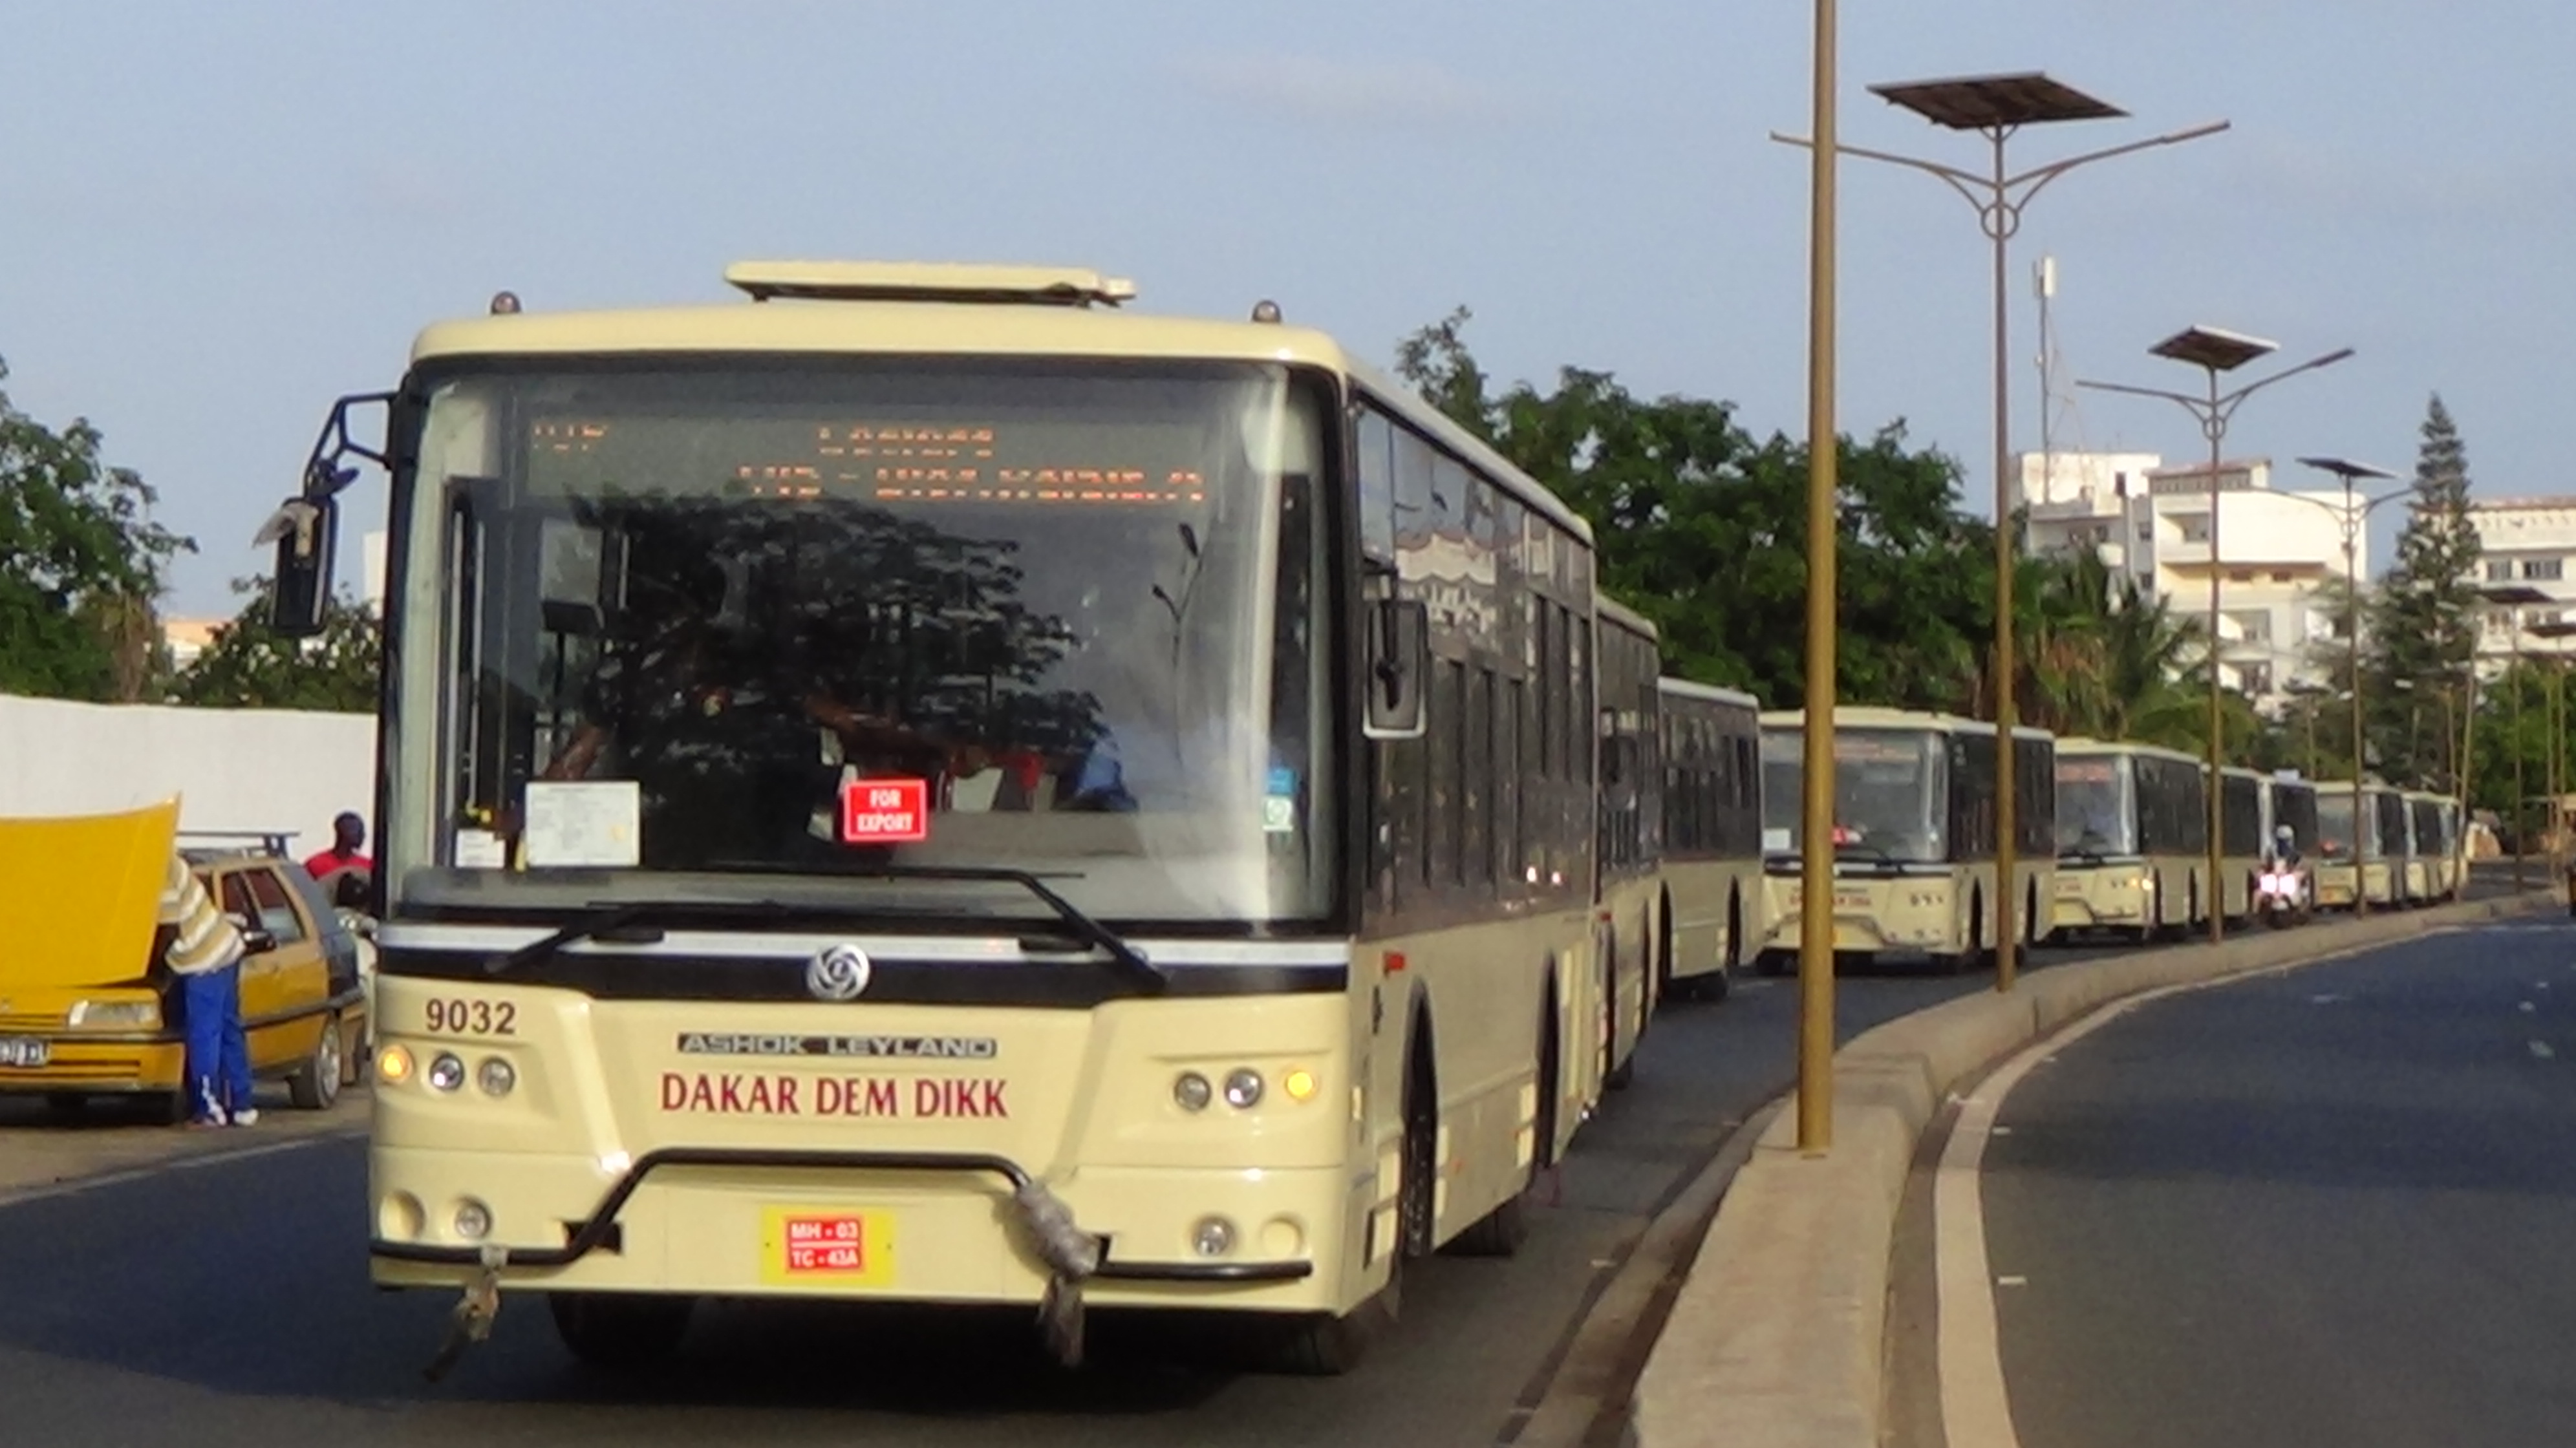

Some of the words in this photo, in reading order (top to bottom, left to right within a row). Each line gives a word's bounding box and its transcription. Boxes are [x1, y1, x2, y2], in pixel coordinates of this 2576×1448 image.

[870, 789, 901, 807] FOR
[857, 813, 913, 832] EXPORT
[426, 998, 516, 1034] 9032
[682, 1034, 808, 1054] ASHOK
[827, 1036, 995, 1058] LEYLAND
[661, 1072, 800, 1114] DAKAR
[816, 1078, 897, 1117] DEM
[915, 1079, 1008, 1118] DIKK
